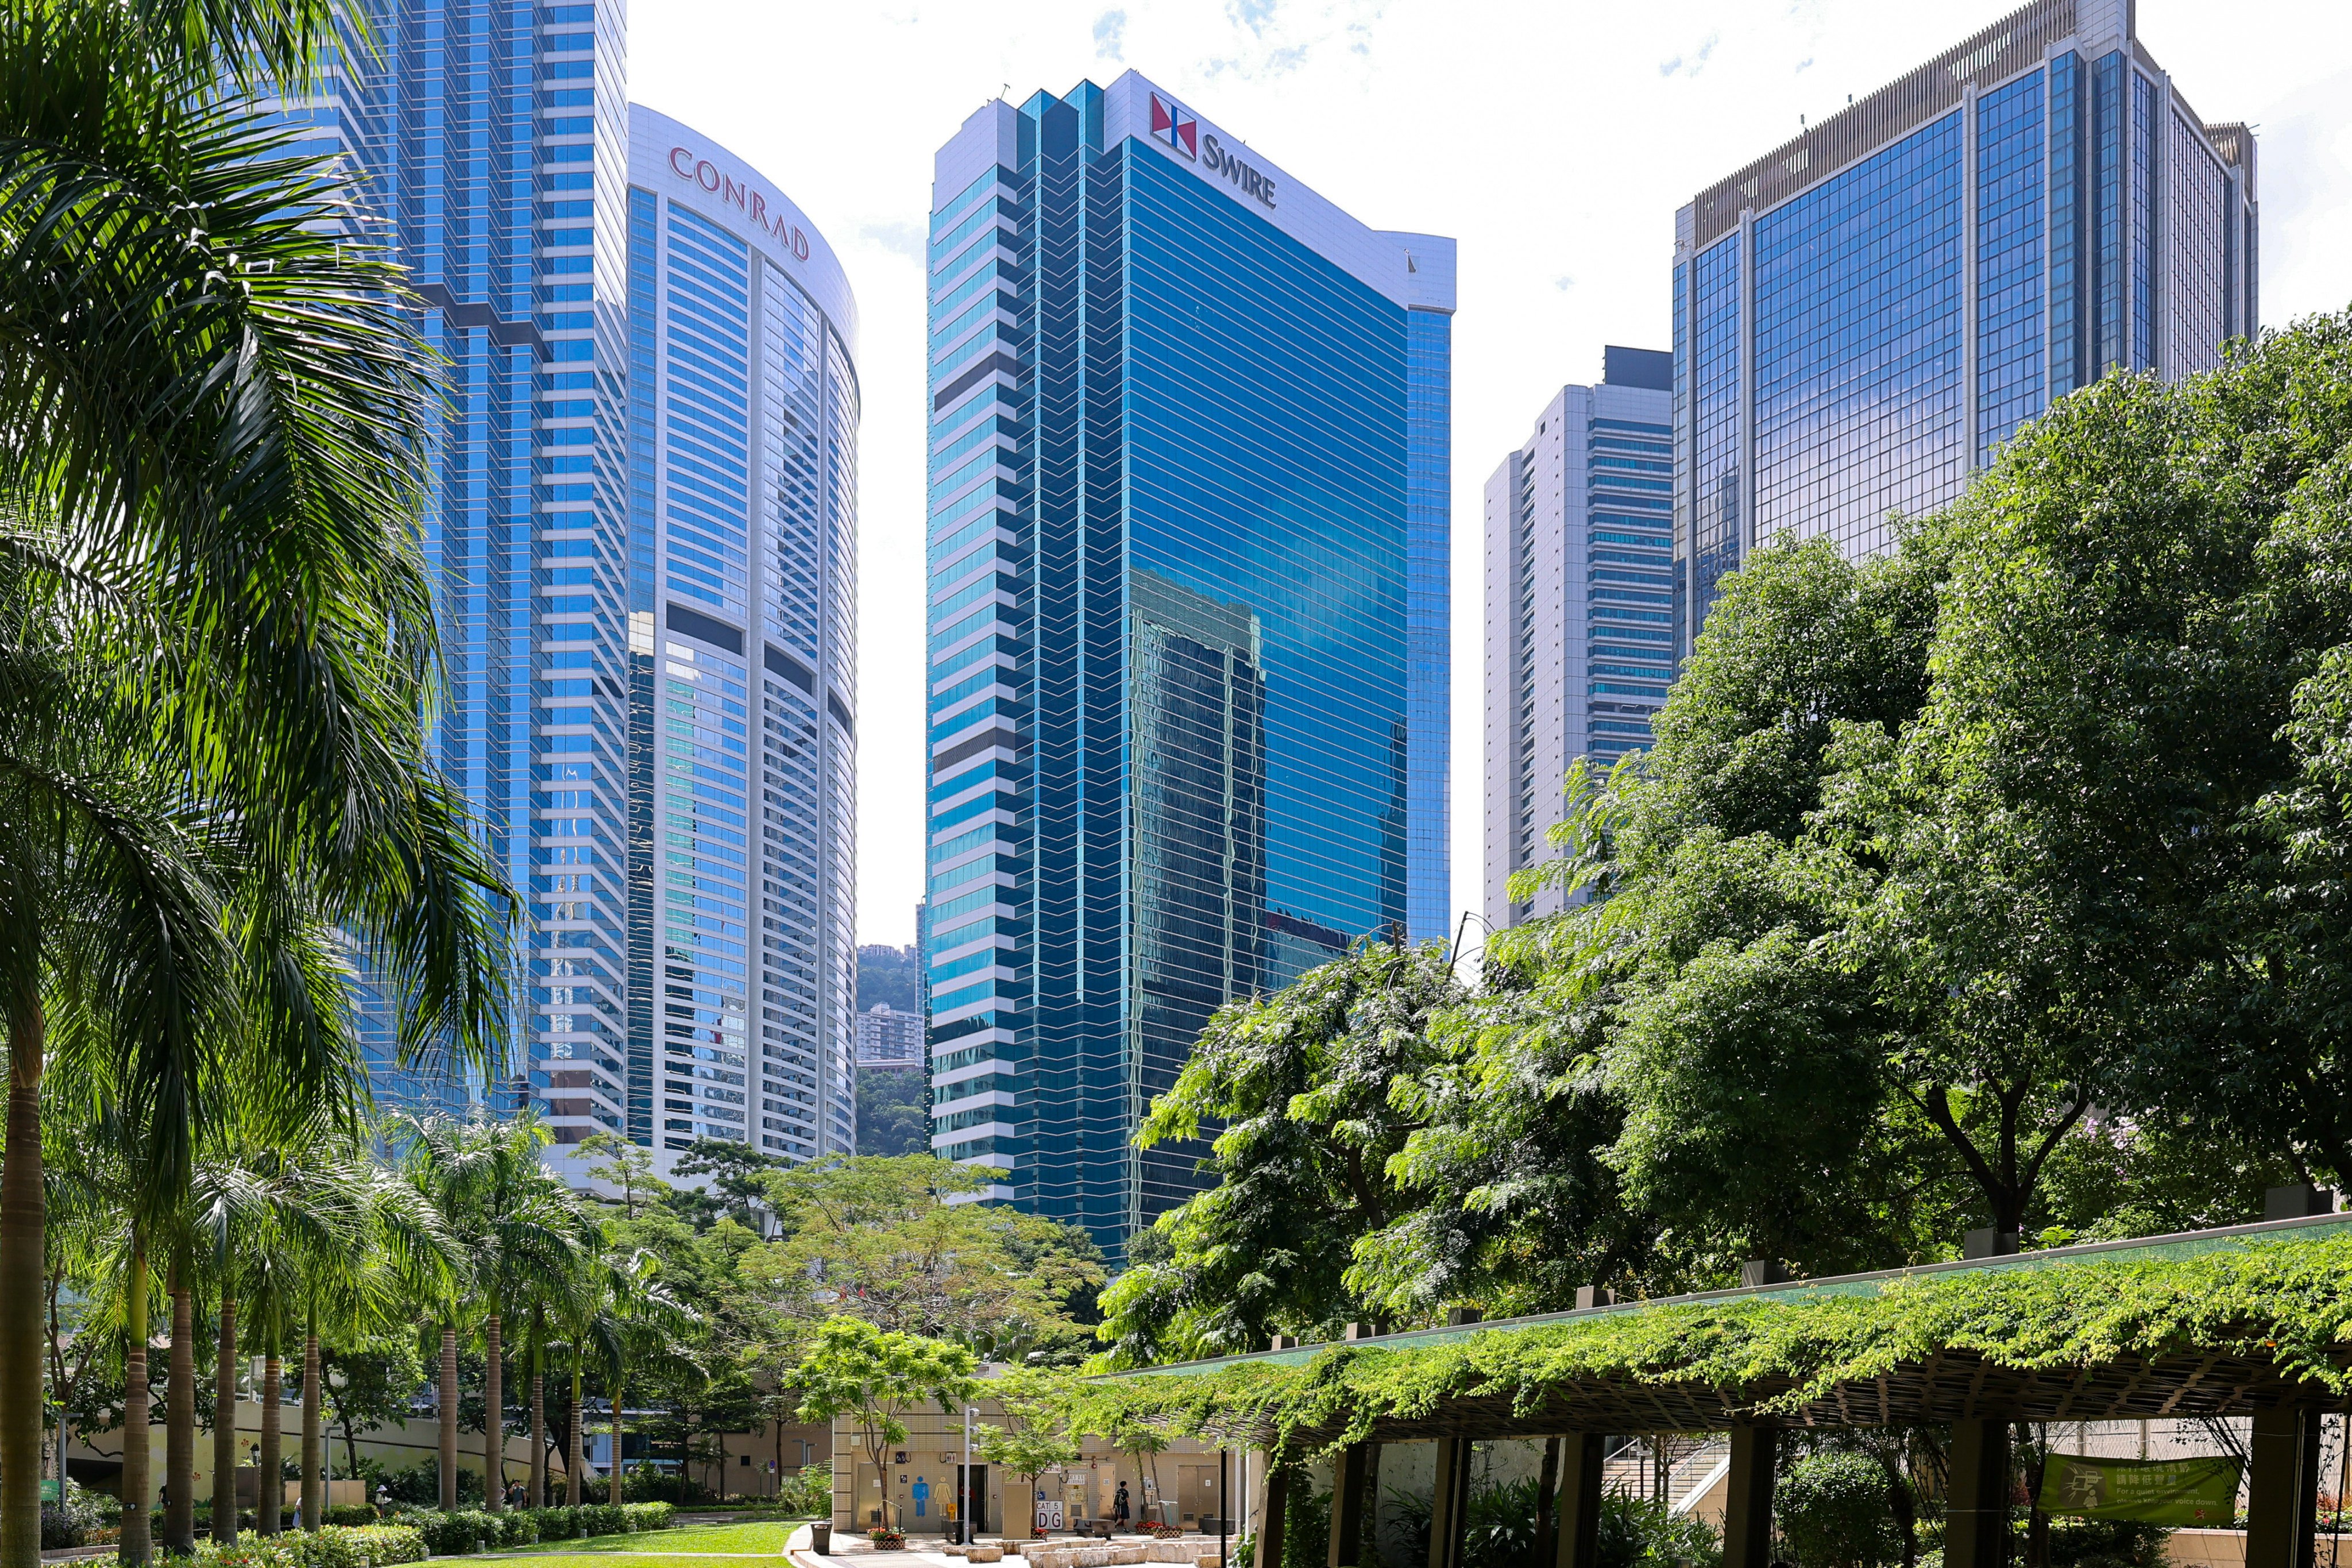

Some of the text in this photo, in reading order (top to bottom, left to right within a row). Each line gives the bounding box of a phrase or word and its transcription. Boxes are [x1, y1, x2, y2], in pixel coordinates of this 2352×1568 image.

[1203, 134, 1276, 210] SWIRE
[669, 147, 809, 261] CONRAD
[2116, 1474, 2176, 1485] 請降低聲量
[2136, 1488, 2154, 1496] quiet
[2196, 1498, 2218, 1506] down.
